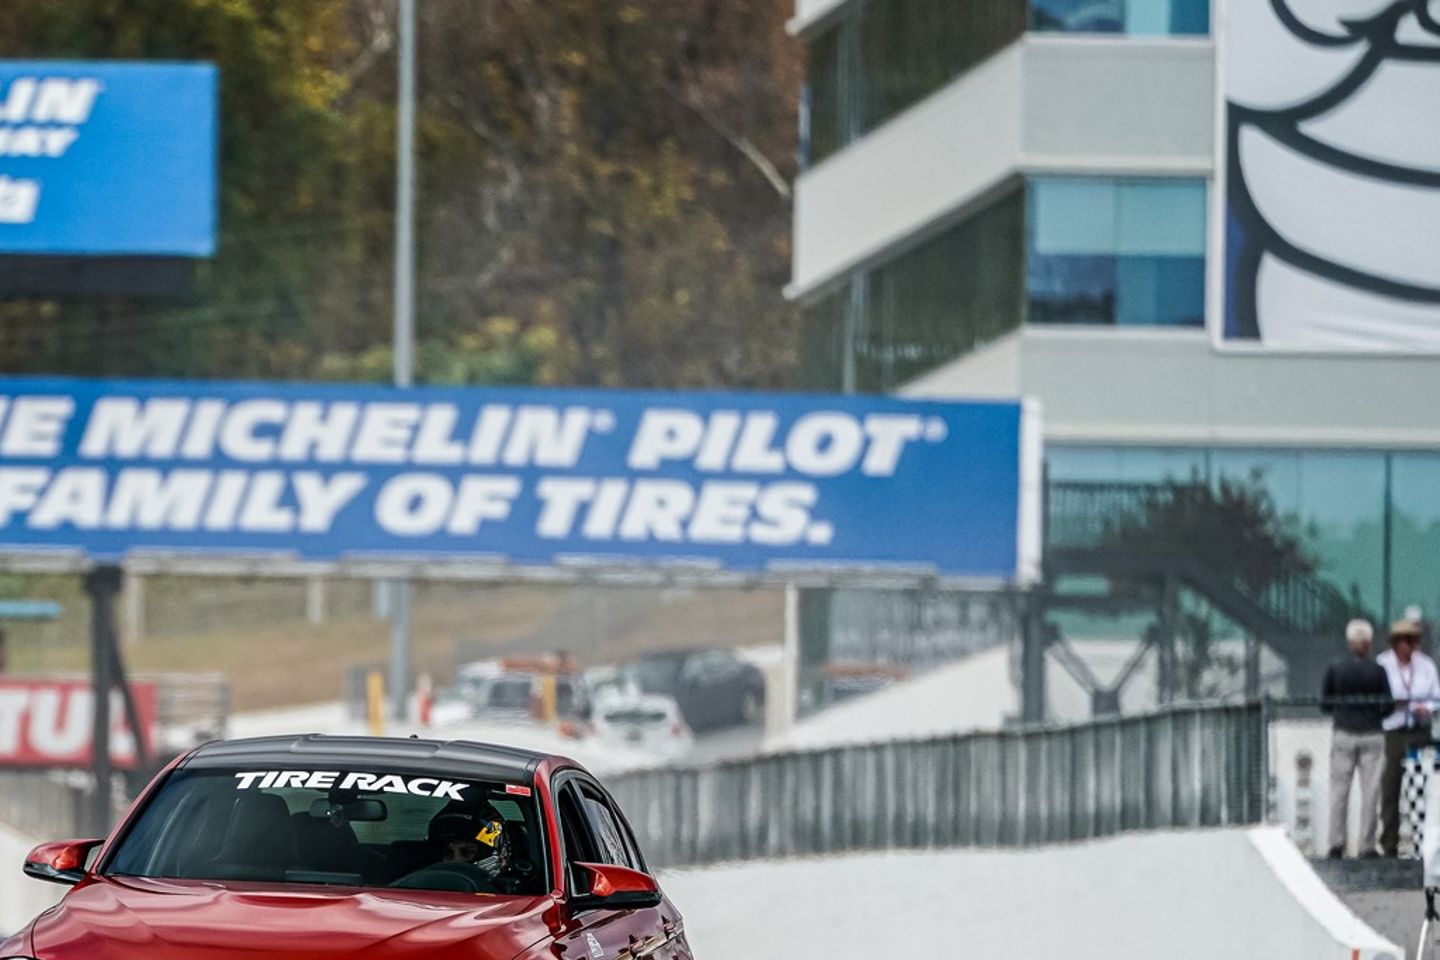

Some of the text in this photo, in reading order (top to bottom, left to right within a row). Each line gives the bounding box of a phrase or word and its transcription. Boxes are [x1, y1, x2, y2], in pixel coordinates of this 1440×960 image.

[374, 472, 521, 536] OF
[536, 476, 835, 545] TIRES.
[235, 771, 470, 801] TIRE RACK
